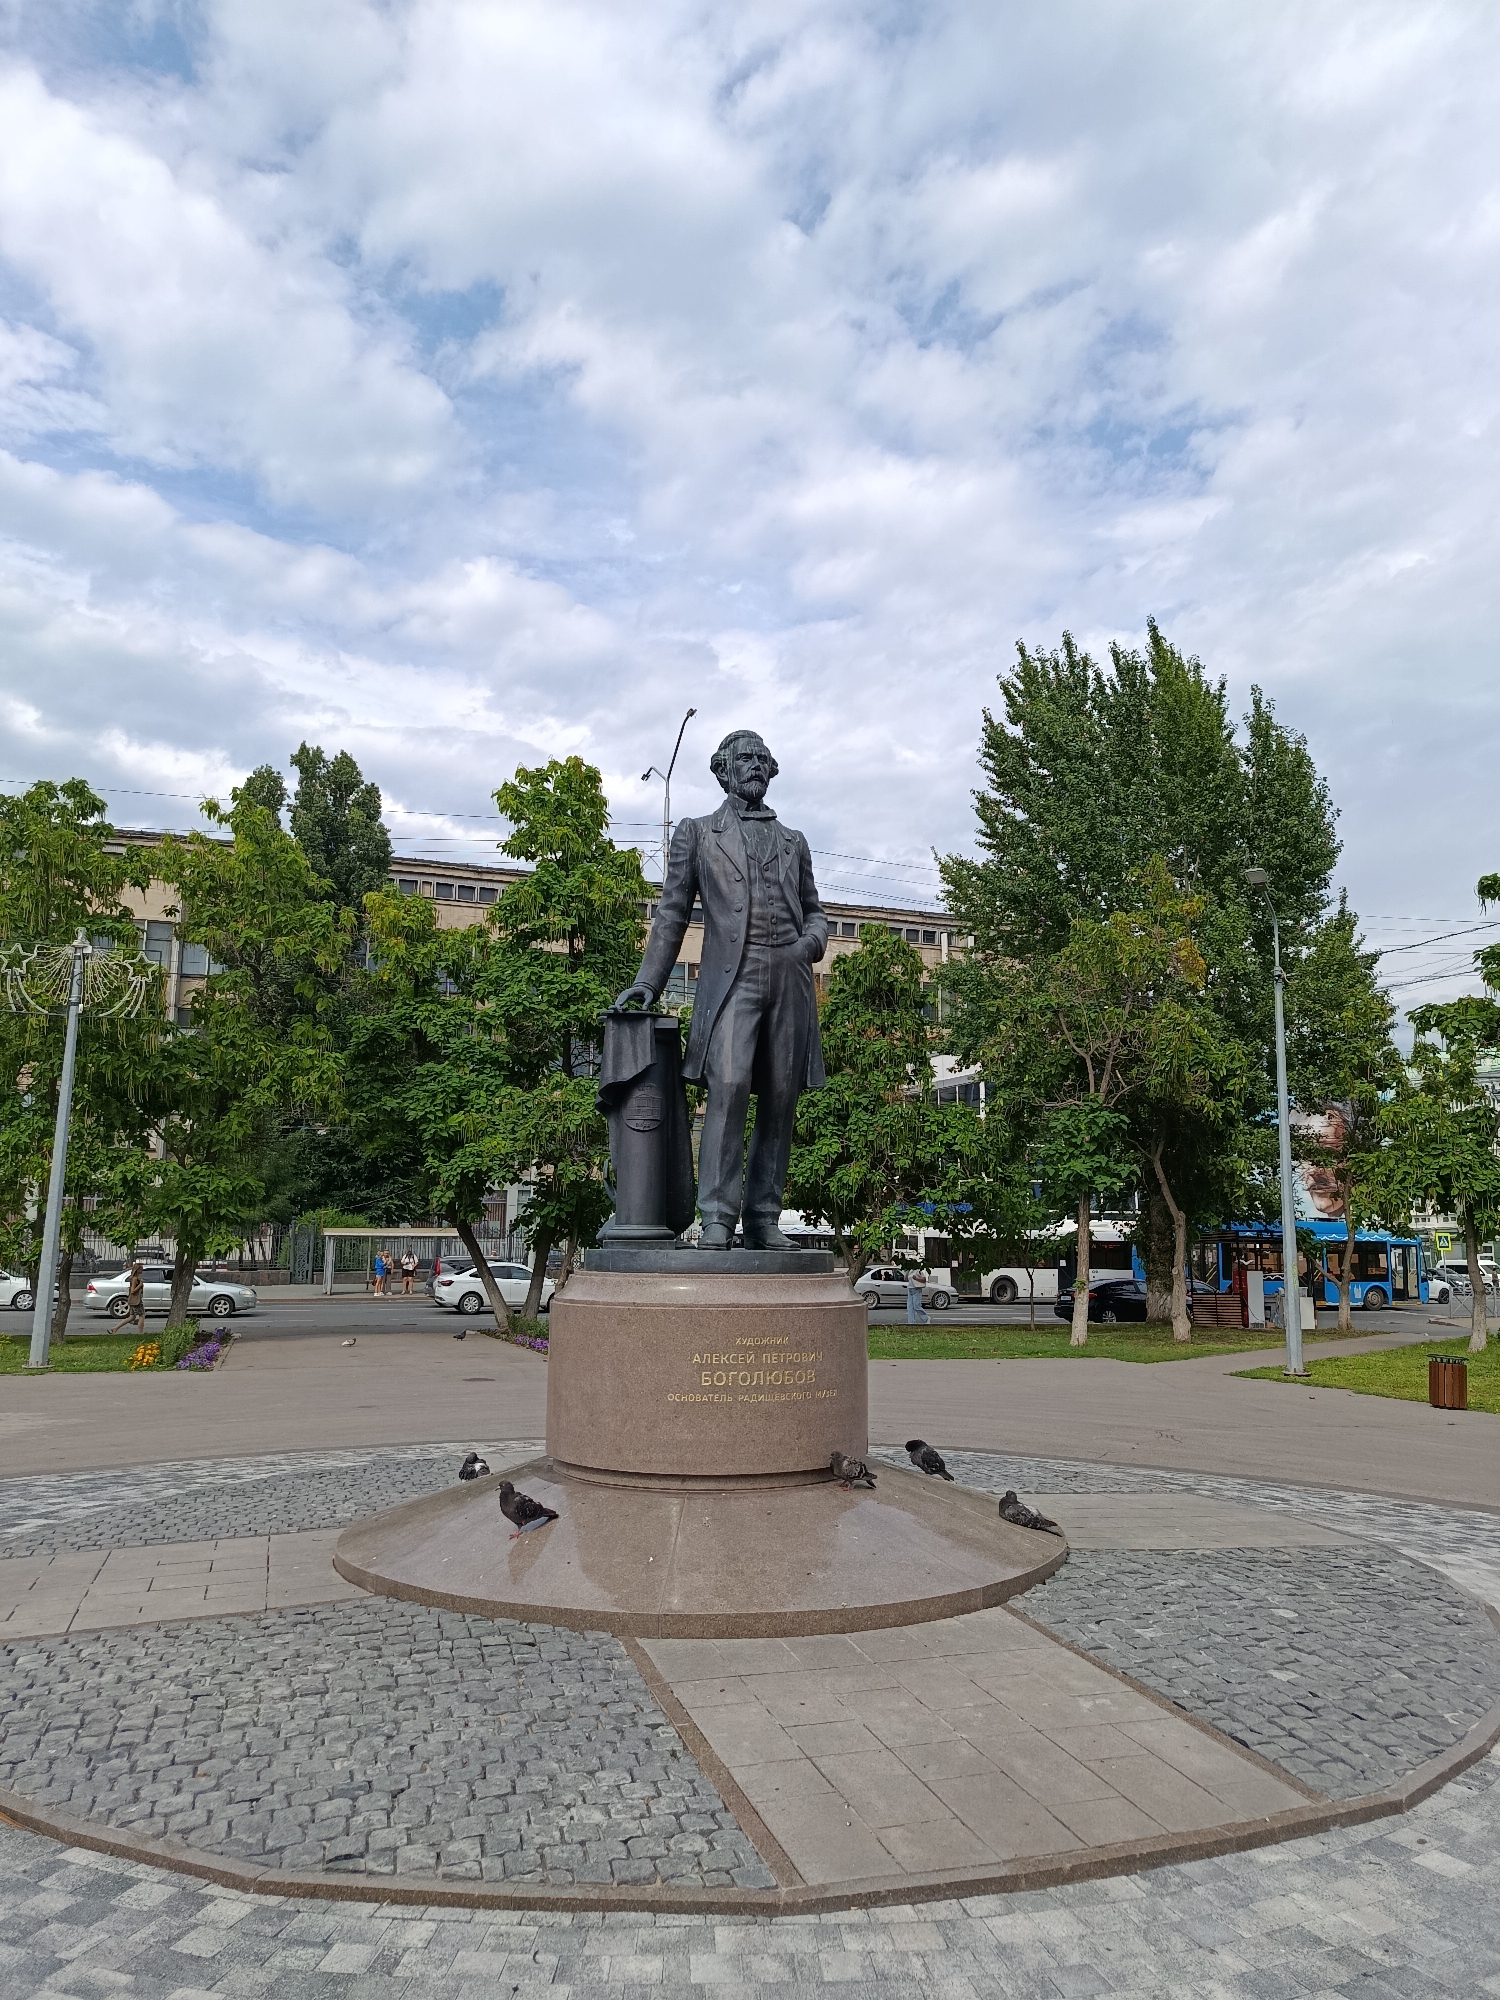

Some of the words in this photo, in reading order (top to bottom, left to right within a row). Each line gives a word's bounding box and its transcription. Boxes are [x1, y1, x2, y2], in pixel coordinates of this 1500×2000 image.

[735, 1336, 789, 1346] ХУДОЖНИК
[692, 1351, 755, 1364] АЛЕКСЕЙ
[762, 1351, 823, 1363] ПЕТРОВИЧ
[701, 1369, 816, 1386] БОГОЛЮБОВ
[667, 1393, 733, 1402] ОСНОВАТЕЛЬ
[738, 1391, 812, 1403] РАДИЩЕВСКОГО
